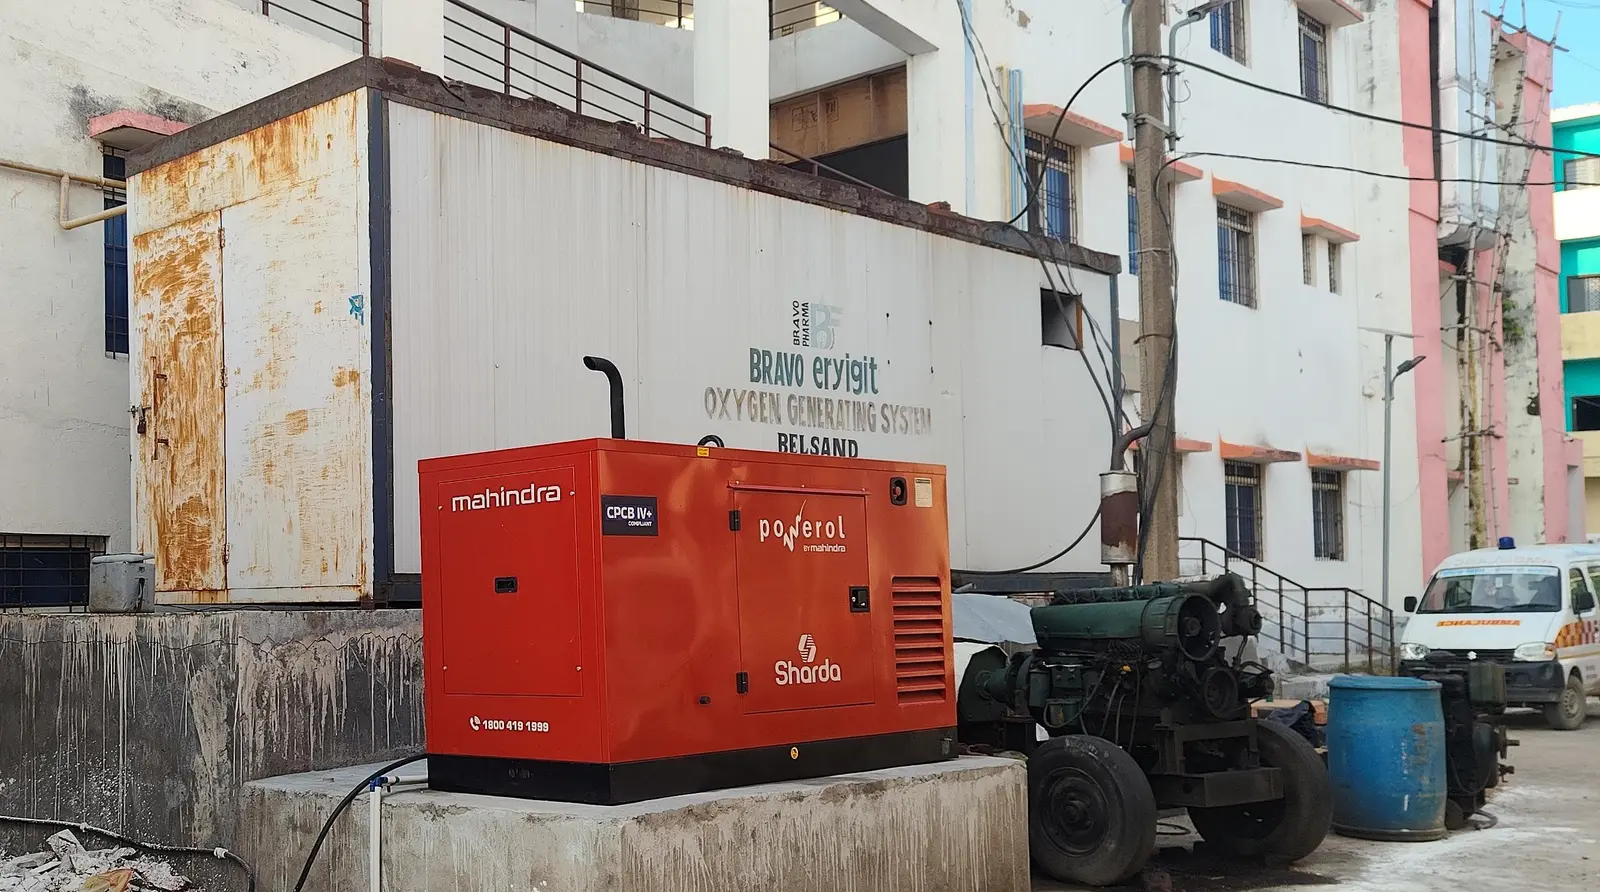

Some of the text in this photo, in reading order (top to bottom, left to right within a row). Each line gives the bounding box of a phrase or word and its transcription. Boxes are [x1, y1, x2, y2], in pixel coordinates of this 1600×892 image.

[750, 348, 879, 395] BRAVO eryigit
[704, 387, 932, 435] OXYGEN GENERATING SYSTEM
[777, 432, 859, 458] BELSAND
[452, 484, 561, 511] mahindra
[606, 506, 652, 520] CPCB IV+
[759, 500, 846, 552] powerol
[810, 544, 846, 552] mahindra
[774, 658, 841, 685] Sharda
[482, 720, 549, 732] 1800 419 1999
